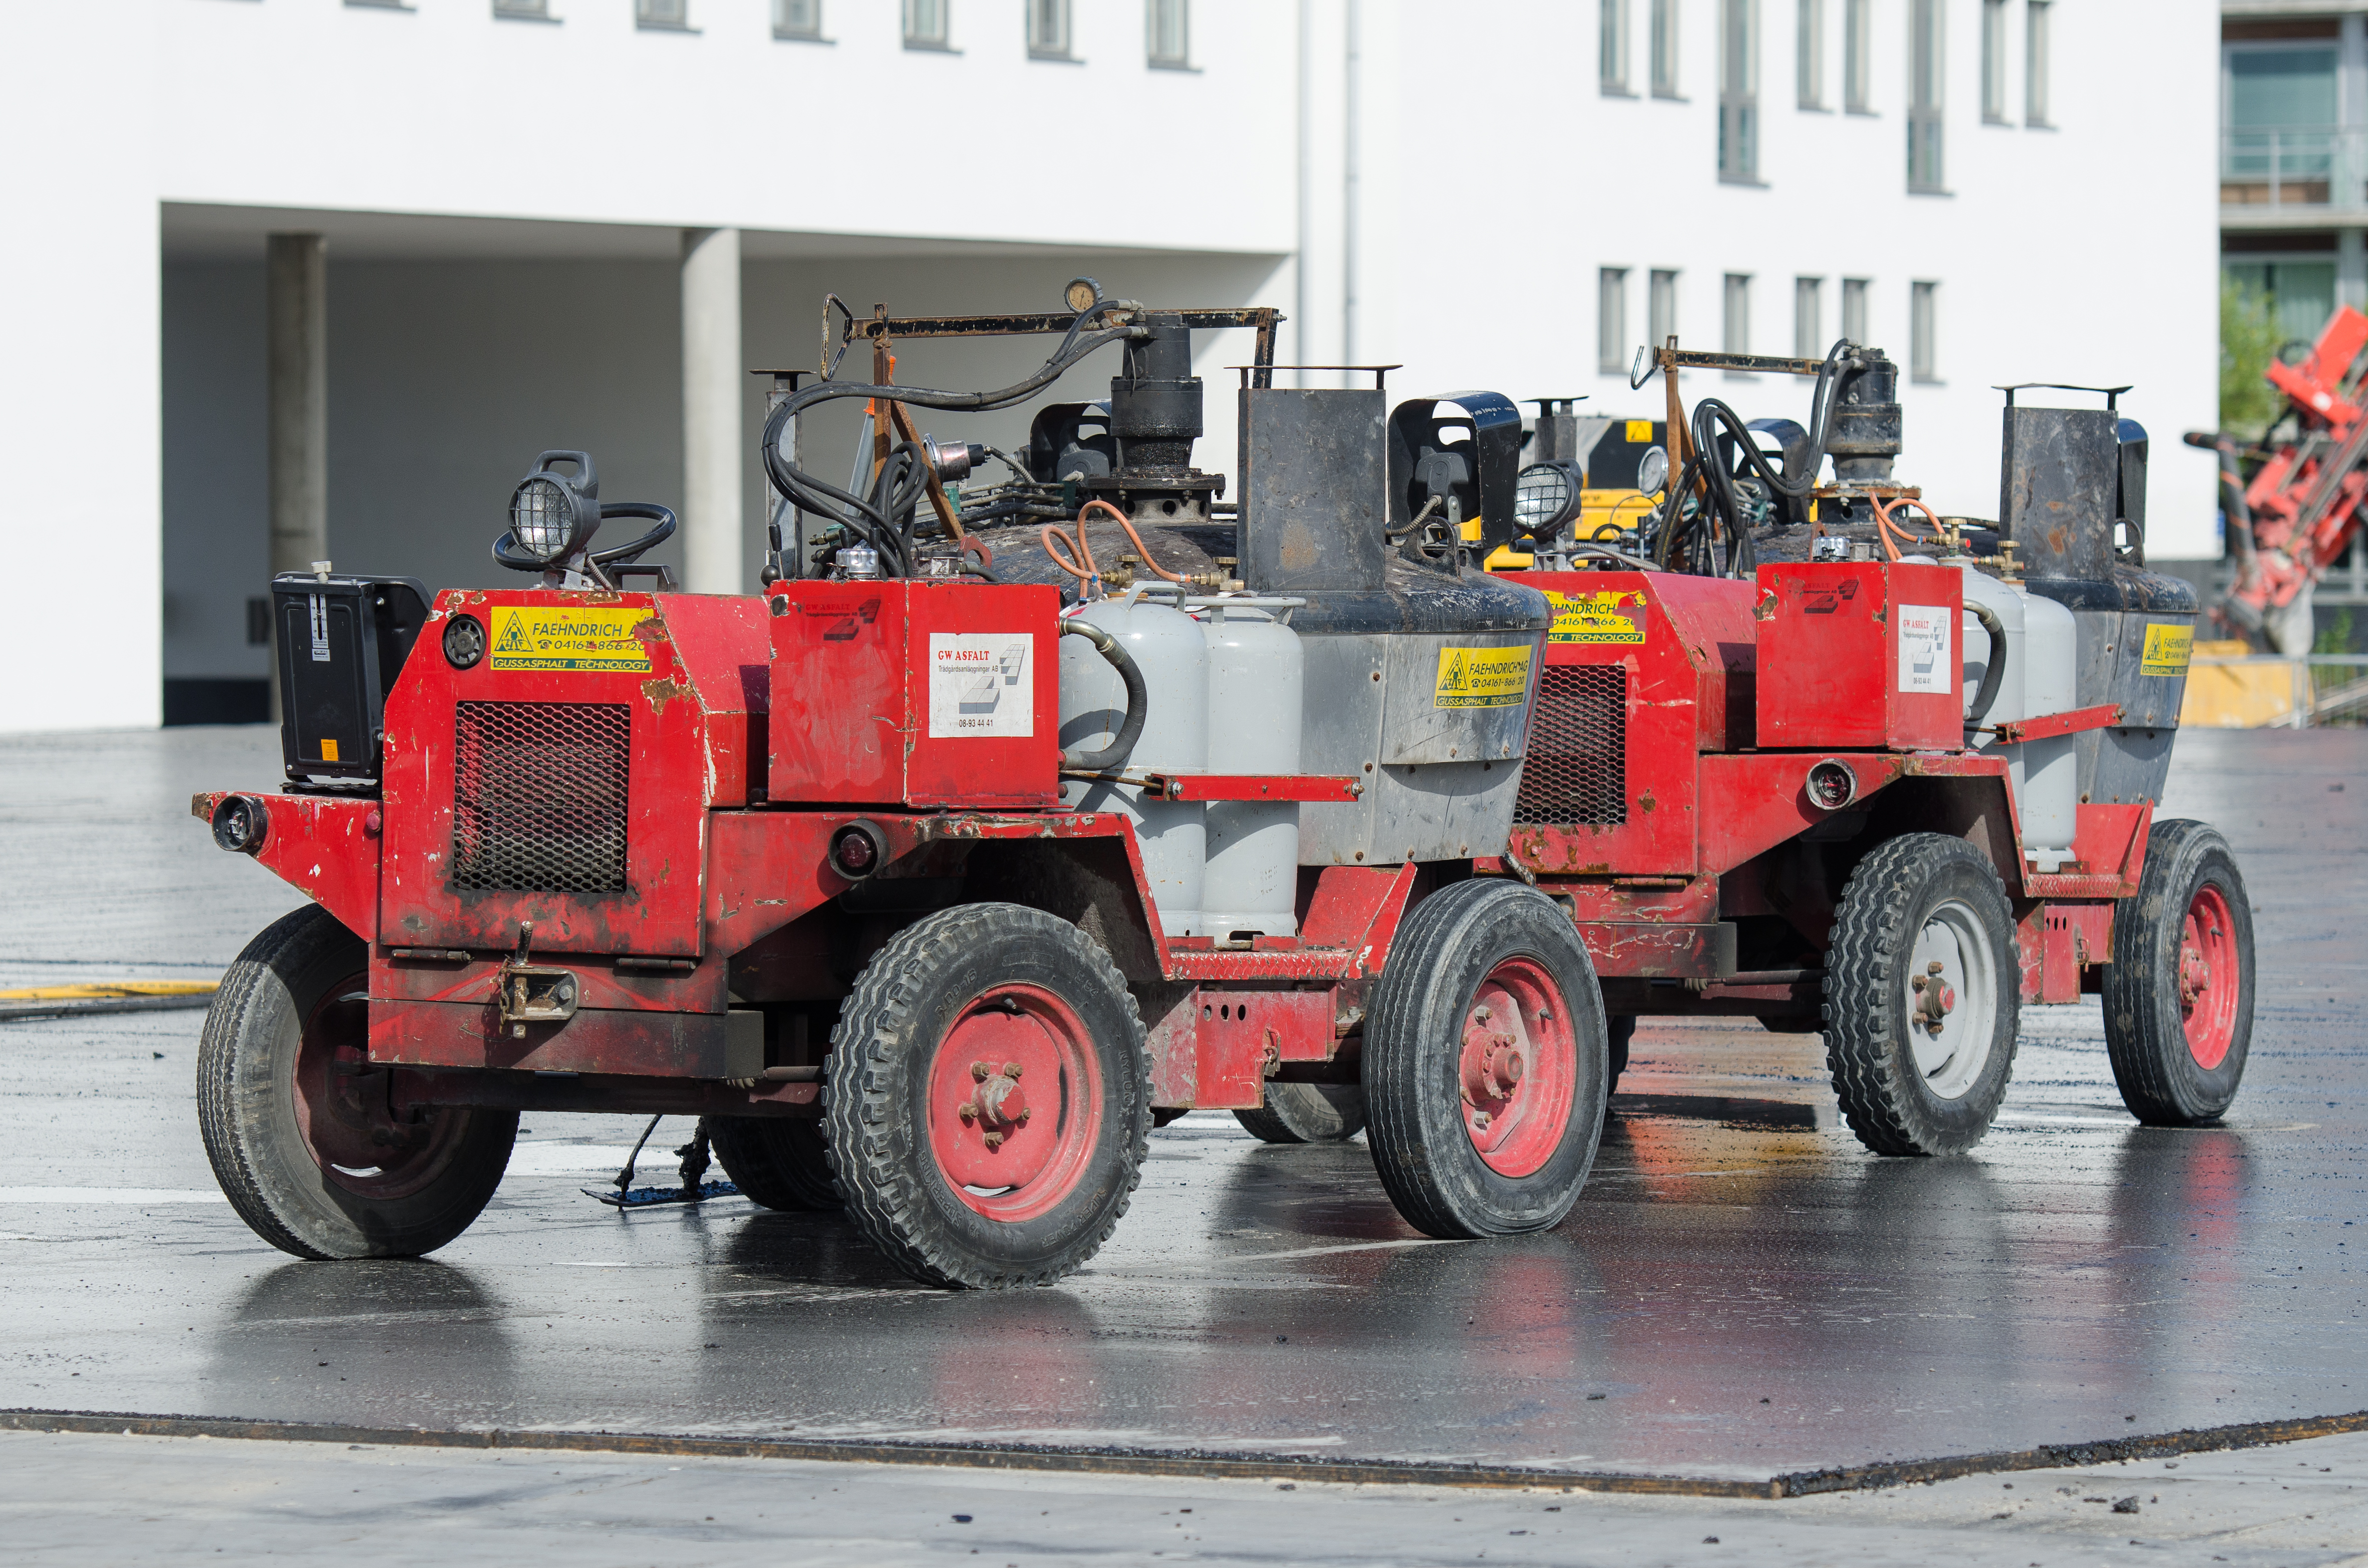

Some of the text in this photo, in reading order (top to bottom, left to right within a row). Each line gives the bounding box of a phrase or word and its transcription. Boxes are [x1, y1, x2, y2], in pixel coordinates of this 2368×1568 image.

[532, 622, 622, 637] FAEHNDRICH
[1903, 619, 1929, 629] GW ASFALT
[938, 650, 990, 661] GW ASFALT
[495, 658, 648, 670] GUSSASPHALT TECHNOLOGY
[1468, 660, 1528, 675] FAEHNDRICH AG
[1481, 675, 1525, 688] 04161-866 20
[1437, 693, 1524, 706] GUSSASPHALT TECHNOLOGY
[959, 719, 976, 728] 08-93
[1118, 1049, 1137, 1106] NYLON
[1041, 1186, 1109, 1249] SUPER POWER
